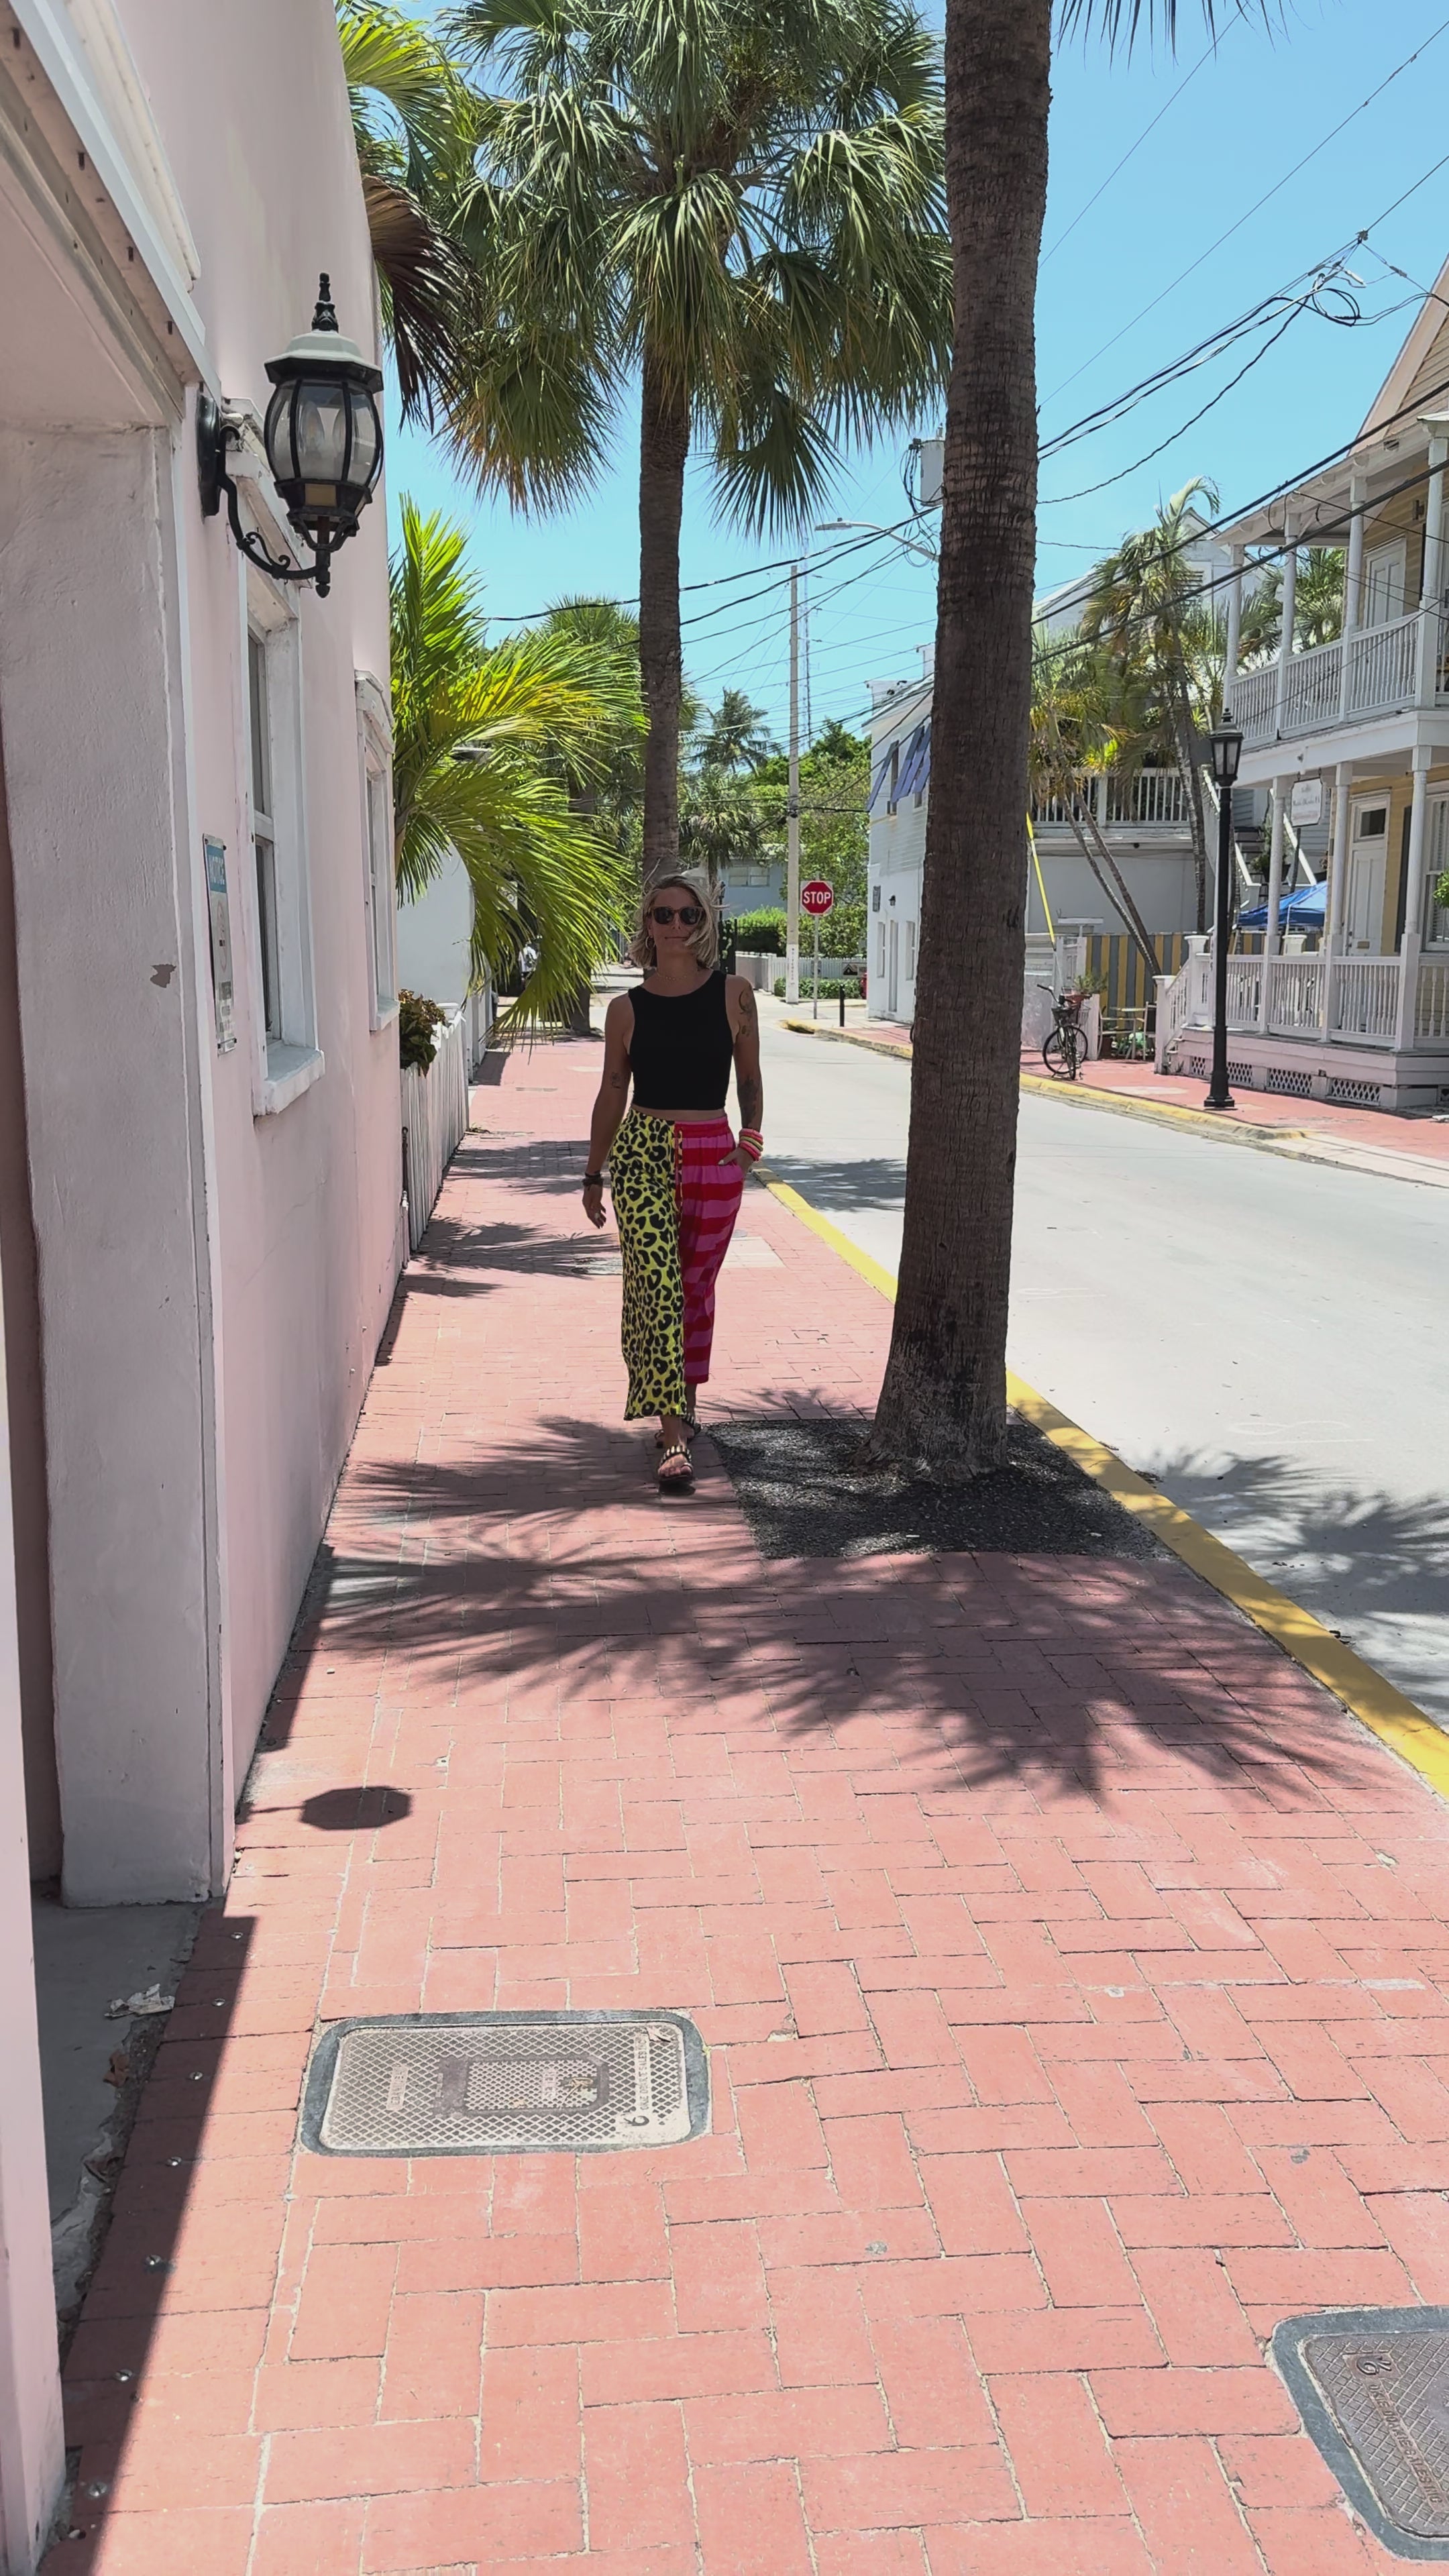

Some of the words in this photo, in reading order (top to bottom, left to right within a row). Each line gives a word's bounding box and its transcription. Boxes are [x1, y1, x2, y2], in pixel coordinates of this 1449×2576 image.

[803, 892, 831, 904] STOP
[1368, 2384, 1389, 2408] OKIE
[1404, 2448, 1432, 2483] SALES
[1424, 2485, 1443, 2504] INC
